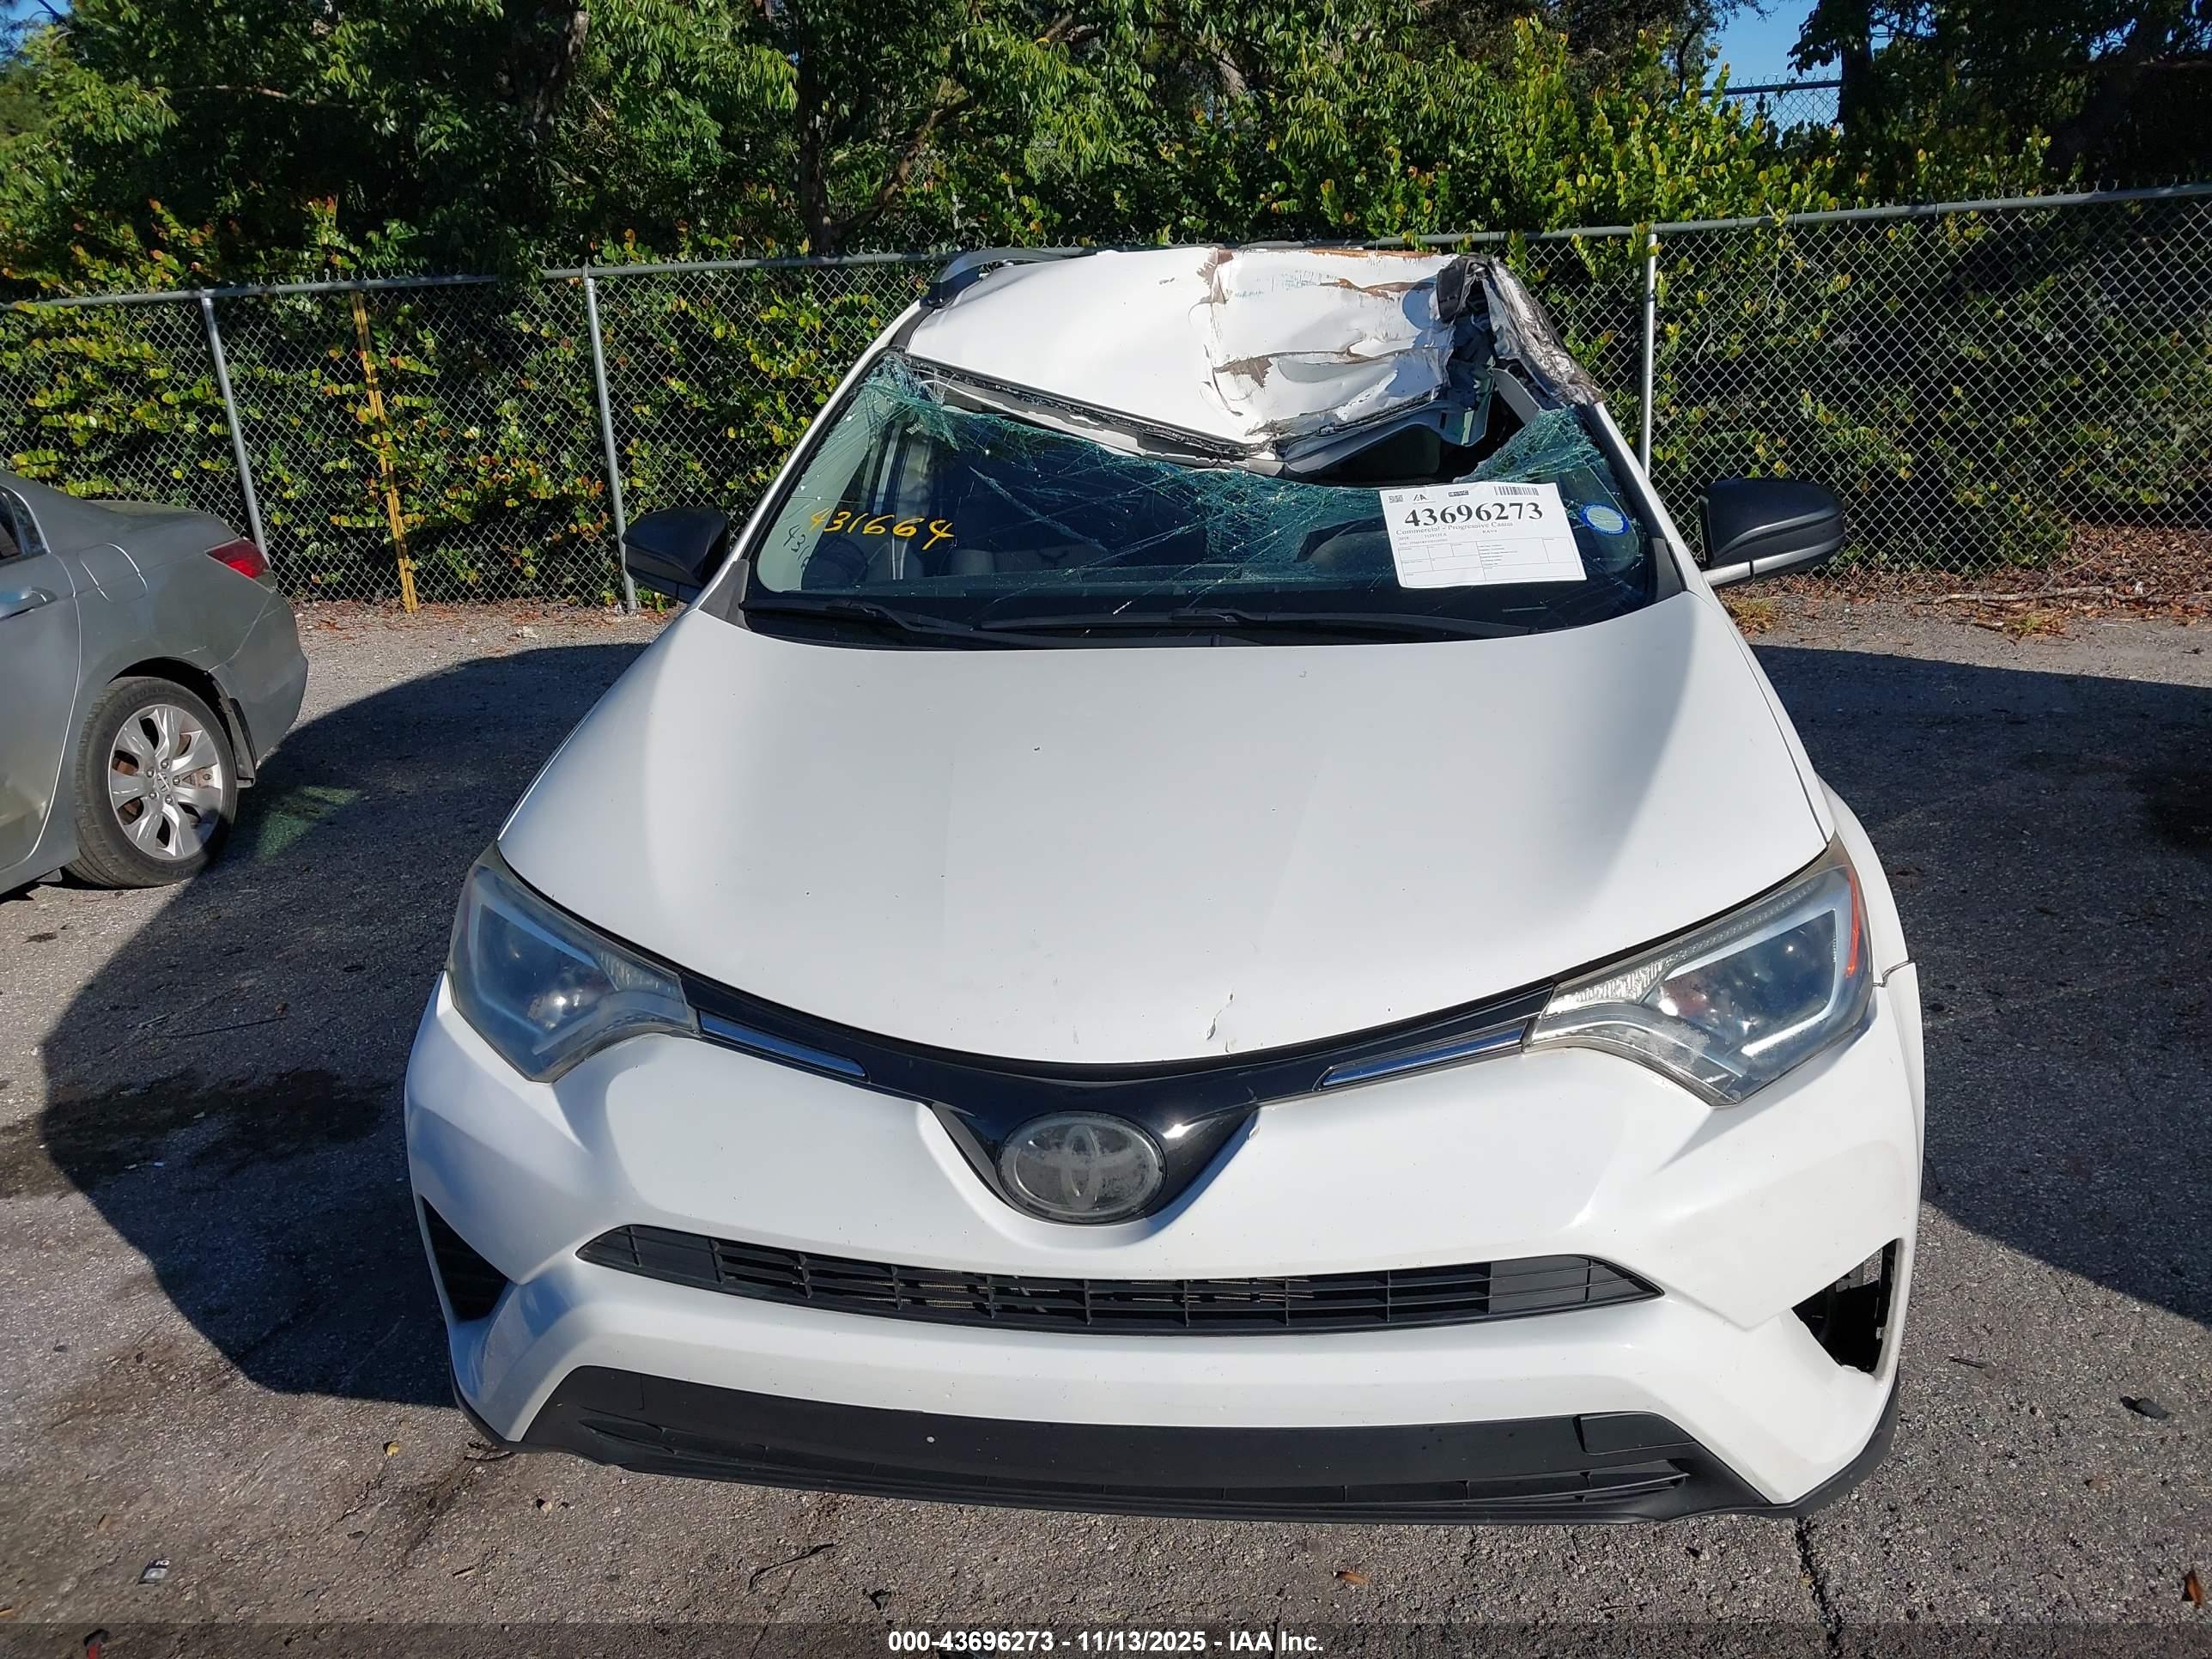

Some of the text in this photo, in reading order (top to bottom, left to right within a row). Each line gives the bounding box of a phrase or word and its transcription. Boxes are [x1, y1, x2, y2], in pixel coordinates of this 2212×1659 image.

[1404, 502, 1543, 526] 43696273
[810, 507, 955, 550] 431664
[1395, 526, 1440, 536] Commercial
